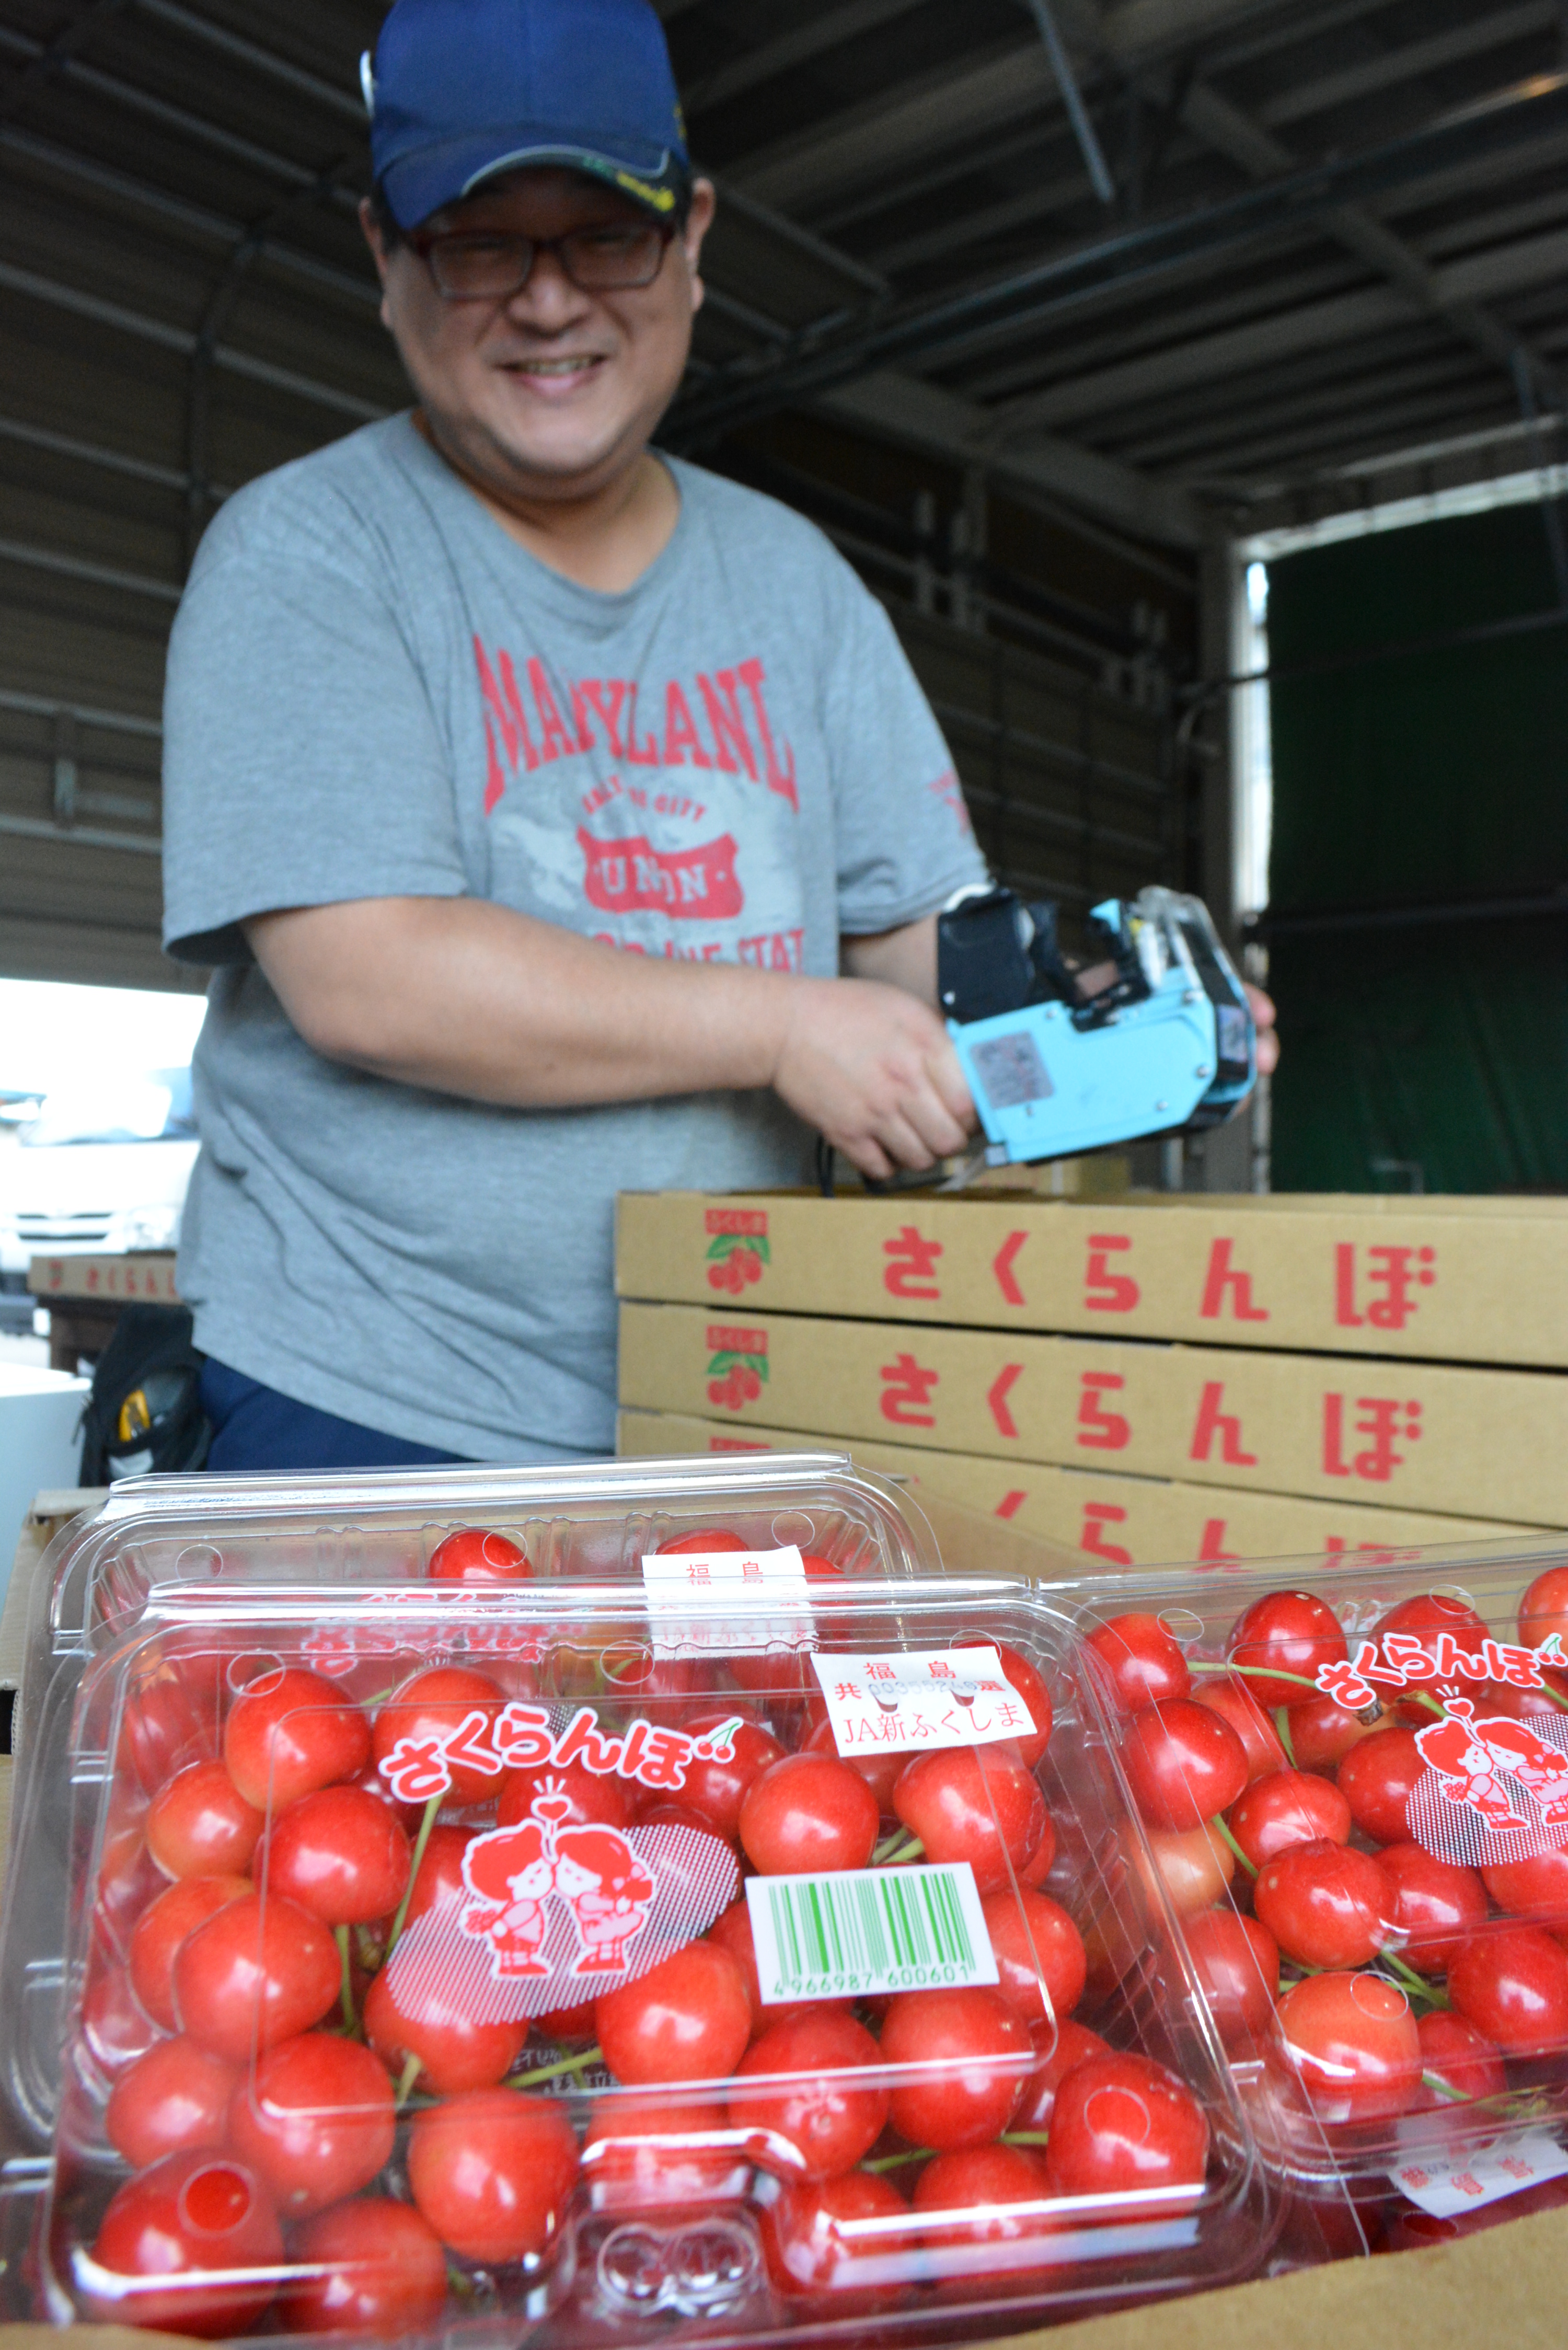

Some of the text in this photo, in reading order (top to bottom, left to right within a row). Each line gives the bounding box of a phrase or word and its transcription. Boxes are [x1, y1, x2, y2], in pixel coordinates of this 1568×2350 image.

[882, 1226, 1437, 1330] さくらんぼ
[879, 1352, 1422, 1483] さくらんぼ
[835, 1683, 862, 1701] 共
[863, 1661, 956, 1679] 福島
[1315, 1632, 1568, 1709] さくらんぼ
[378, 1702, 744, 1803] さくらんぼ
[843, 1702, 1024, 1744] JA新ふくしま
